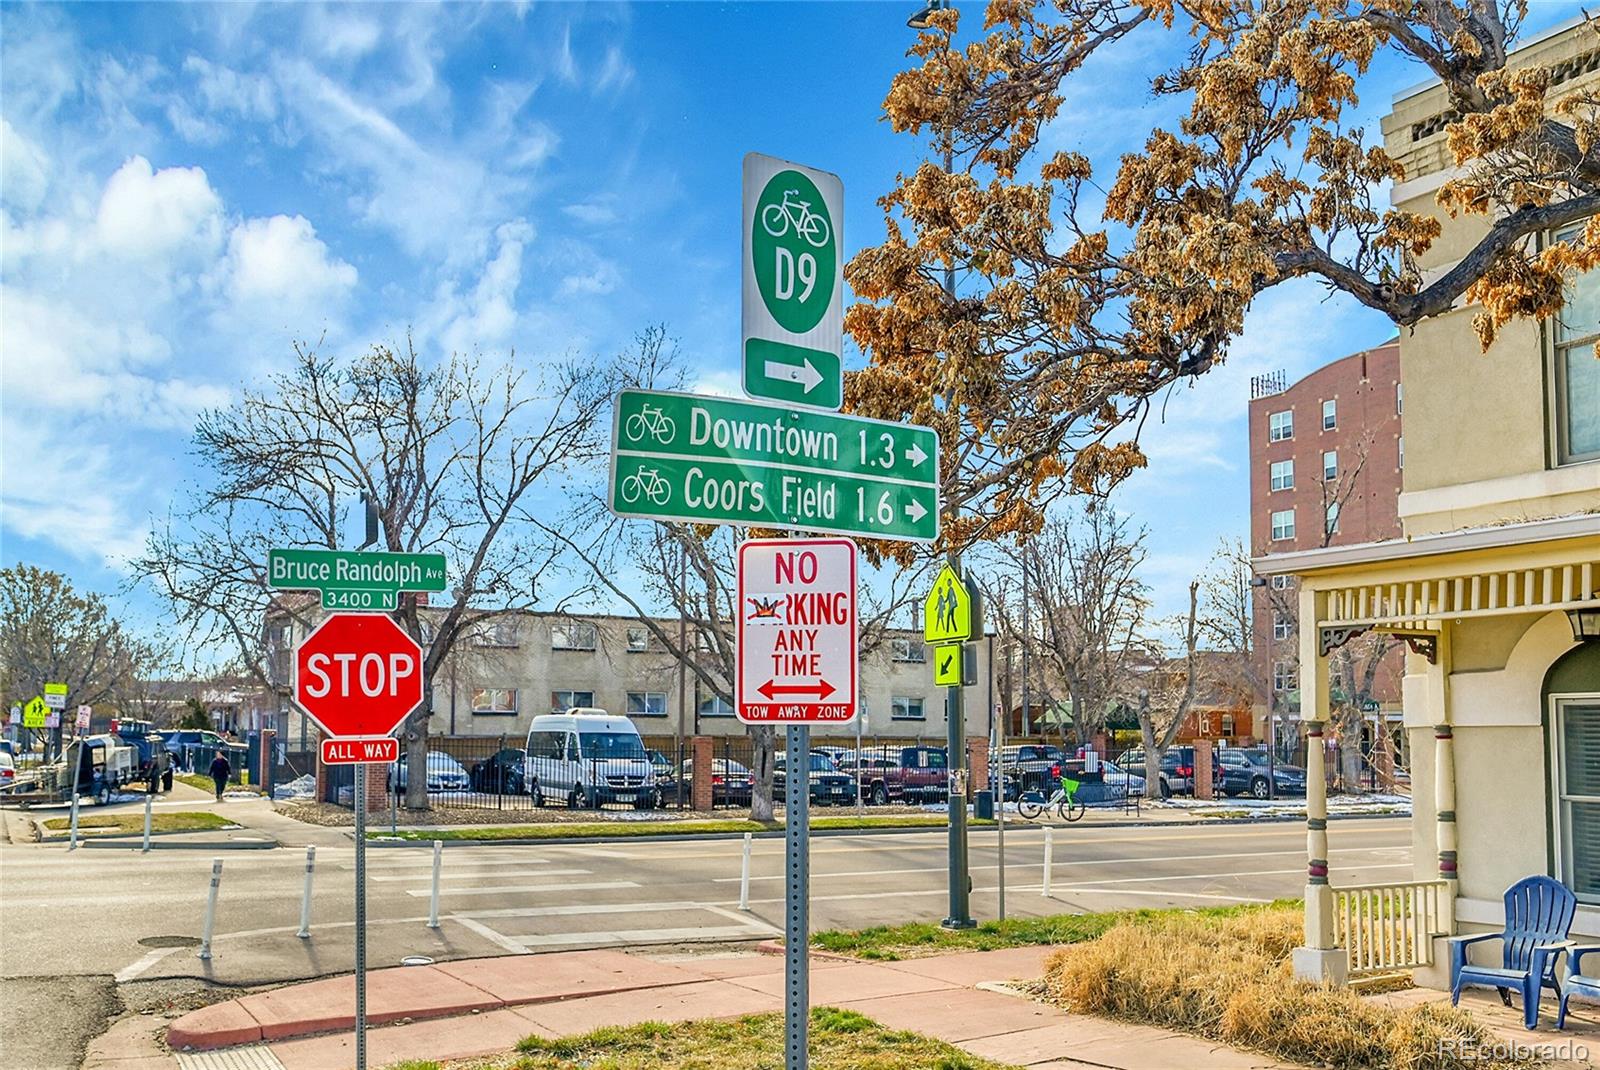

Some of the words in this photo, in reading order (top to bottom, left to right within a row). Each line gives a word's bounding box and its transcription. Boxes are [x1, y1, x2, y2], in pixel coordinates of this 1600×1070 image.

[775, 246, 817, 304] D9
[690, 407, 838, 461] Downtown
[859, 430, 895, 469] 1.3
[685, 467, 764, 512] Coors
[782, 475, 836, 519] Field
[857, 487, 894, 525] 1.6
[273, 556, 330, 580] Bruce
[336, 559, 422, 587] Randolph
[426, 569, 443, 580] Ave
[775, 551, 818, 585] NO
[327, 592, 372, 607] 3400
[382, 593, 393, 607] N
[774, 629, 818, 651] ANY
[305, 652, 415, 698] STOP
[771, 654, 822, 676] TIME
[746, 706, 769, 718] TOW
[778, 706, 808, 718] AWAY
[817, 705, 848, 718] ZONE
[328, 745, 355, 759] ALL
[364, 743, 392, 758] WAY
